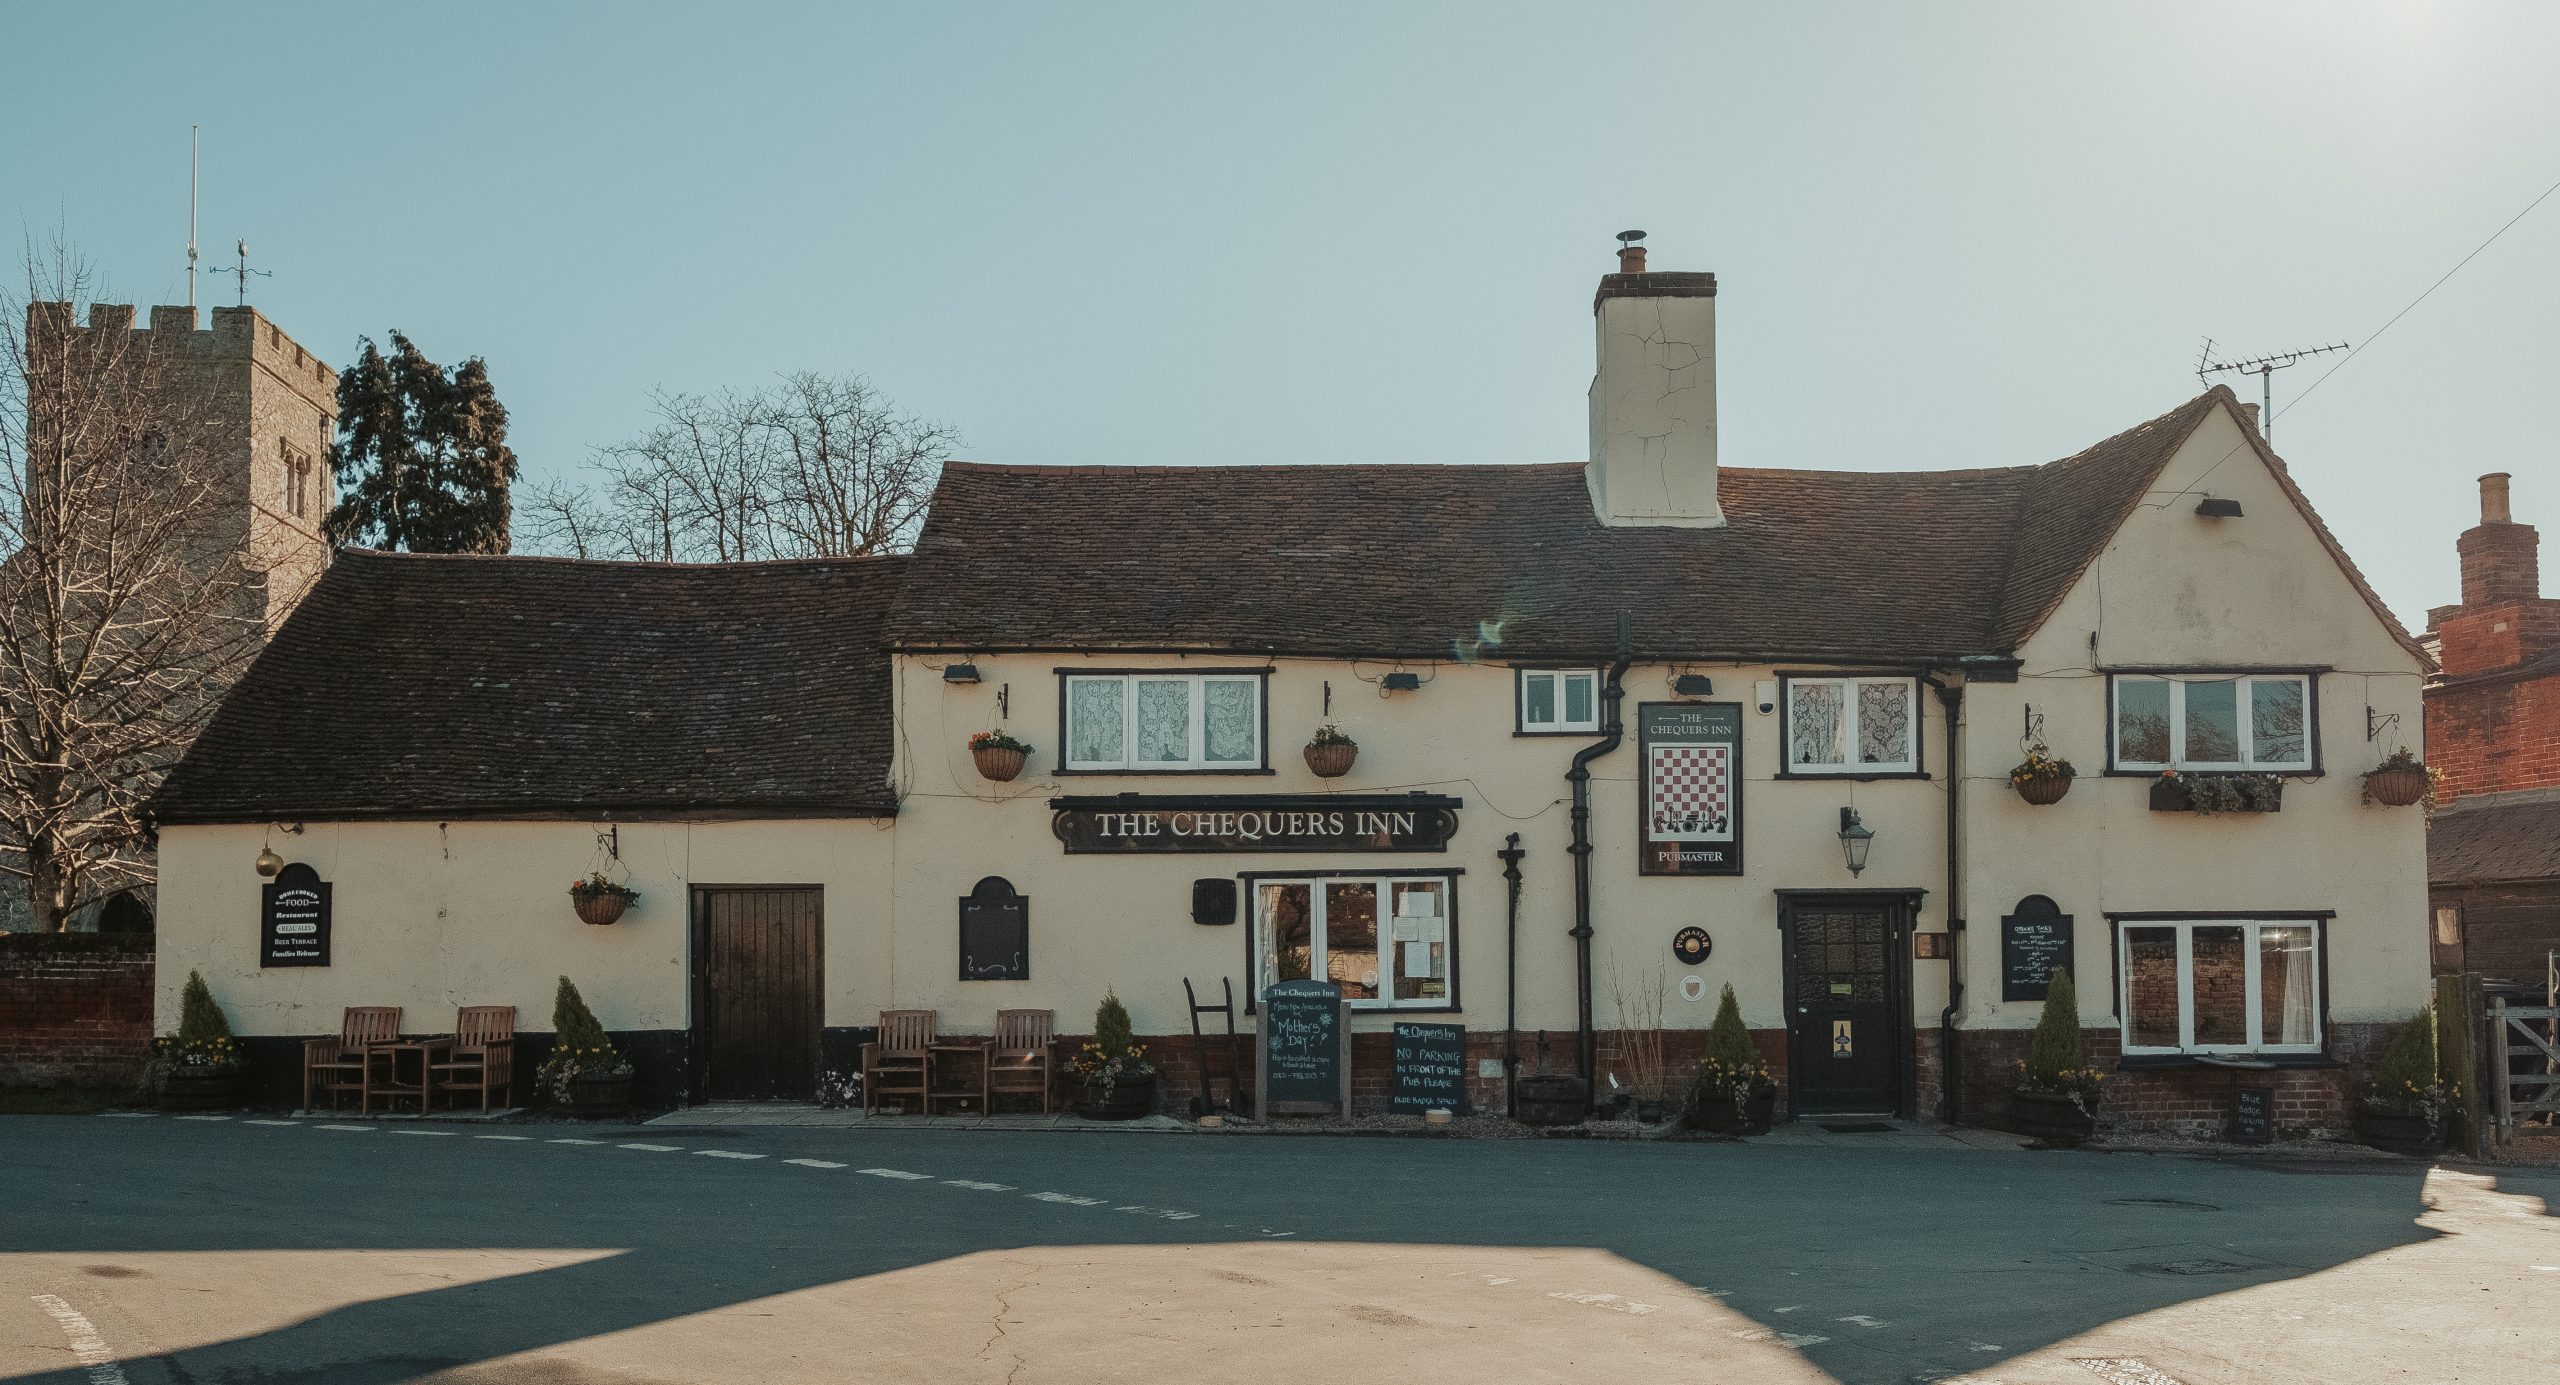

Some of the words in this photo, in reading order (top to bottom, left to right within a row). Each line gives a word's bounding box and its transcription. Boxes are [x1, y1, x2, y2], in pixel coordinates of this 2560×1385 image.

[1680, 714, 1702, 722] THE
[1650, 725, 1708, 735] CHEQUERS
[1711, 726, 1732, 734] INN
[1096, 812, 1160, 836] THE
[1170, 812, 1344, 840] CHEQUERS
[1355, 812, 1415, 836] INN
[1658, 851, 1723, 862] PUBMASTER
[1676, 930, 1710, 948] PUBMASTER
[1289, 989, 1320, 997] Chequers
[1396, 1026, 1409, 1035] The
[1412, 1026, 1443, 1043] Chequers
[1444, 1028, 1455, 1040] Inn
[1397, 1048, 1412, 1058] NO
[1420, 1049, 1460, 1065] PARKING
[1409, 1065, 1436, 1074] FRONT
[1437, 1066, 1447, 1074] OF
[1448, 1067, 1462, 1076] THE
[1403, 1076, 1420, 1086] PUB
[1424, 1077, 1452, 1088] PLEASE
[1412, 1097, 1434, 1105] BADGE
